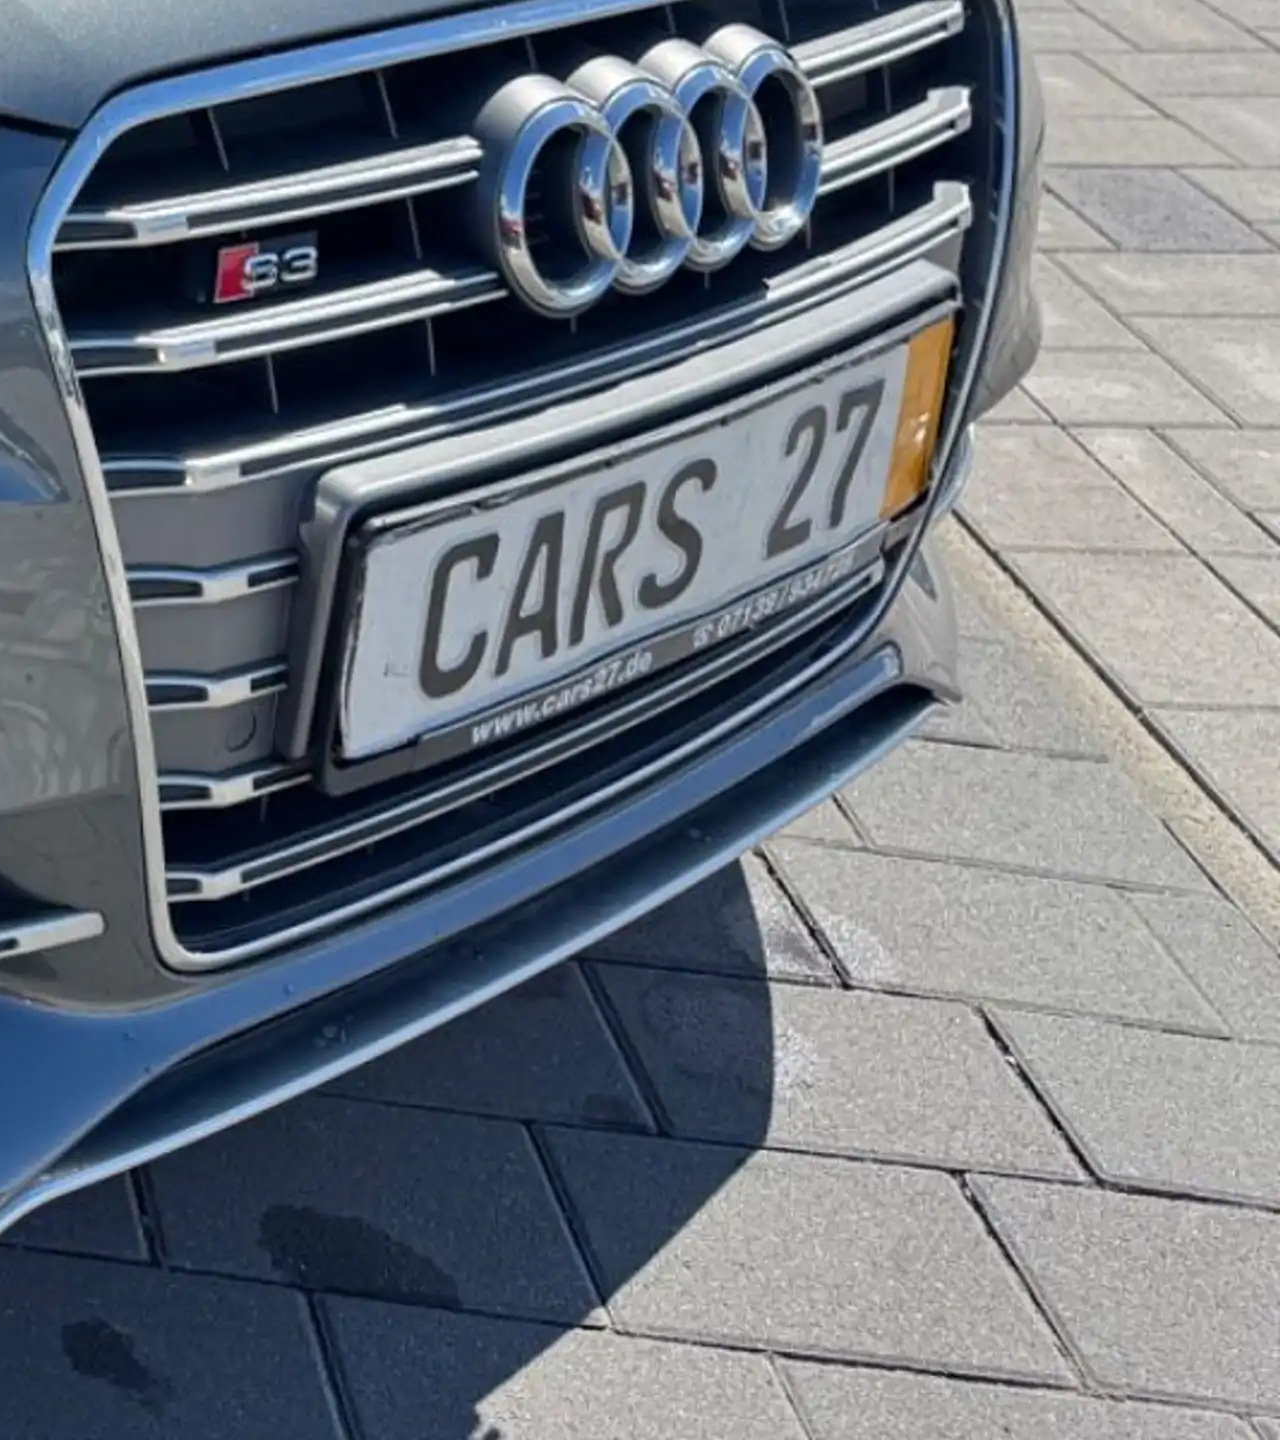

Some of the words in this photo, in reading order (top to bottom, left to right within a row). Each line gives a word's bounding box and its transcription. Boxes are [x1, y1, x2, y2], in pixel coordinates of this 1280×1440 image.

[241, 246, 317, 290] S3
[419, 458, 717, 699] CARS
[766, 378, 885, 558] 27
[471, 651, 653, 744] www.cars27.de
